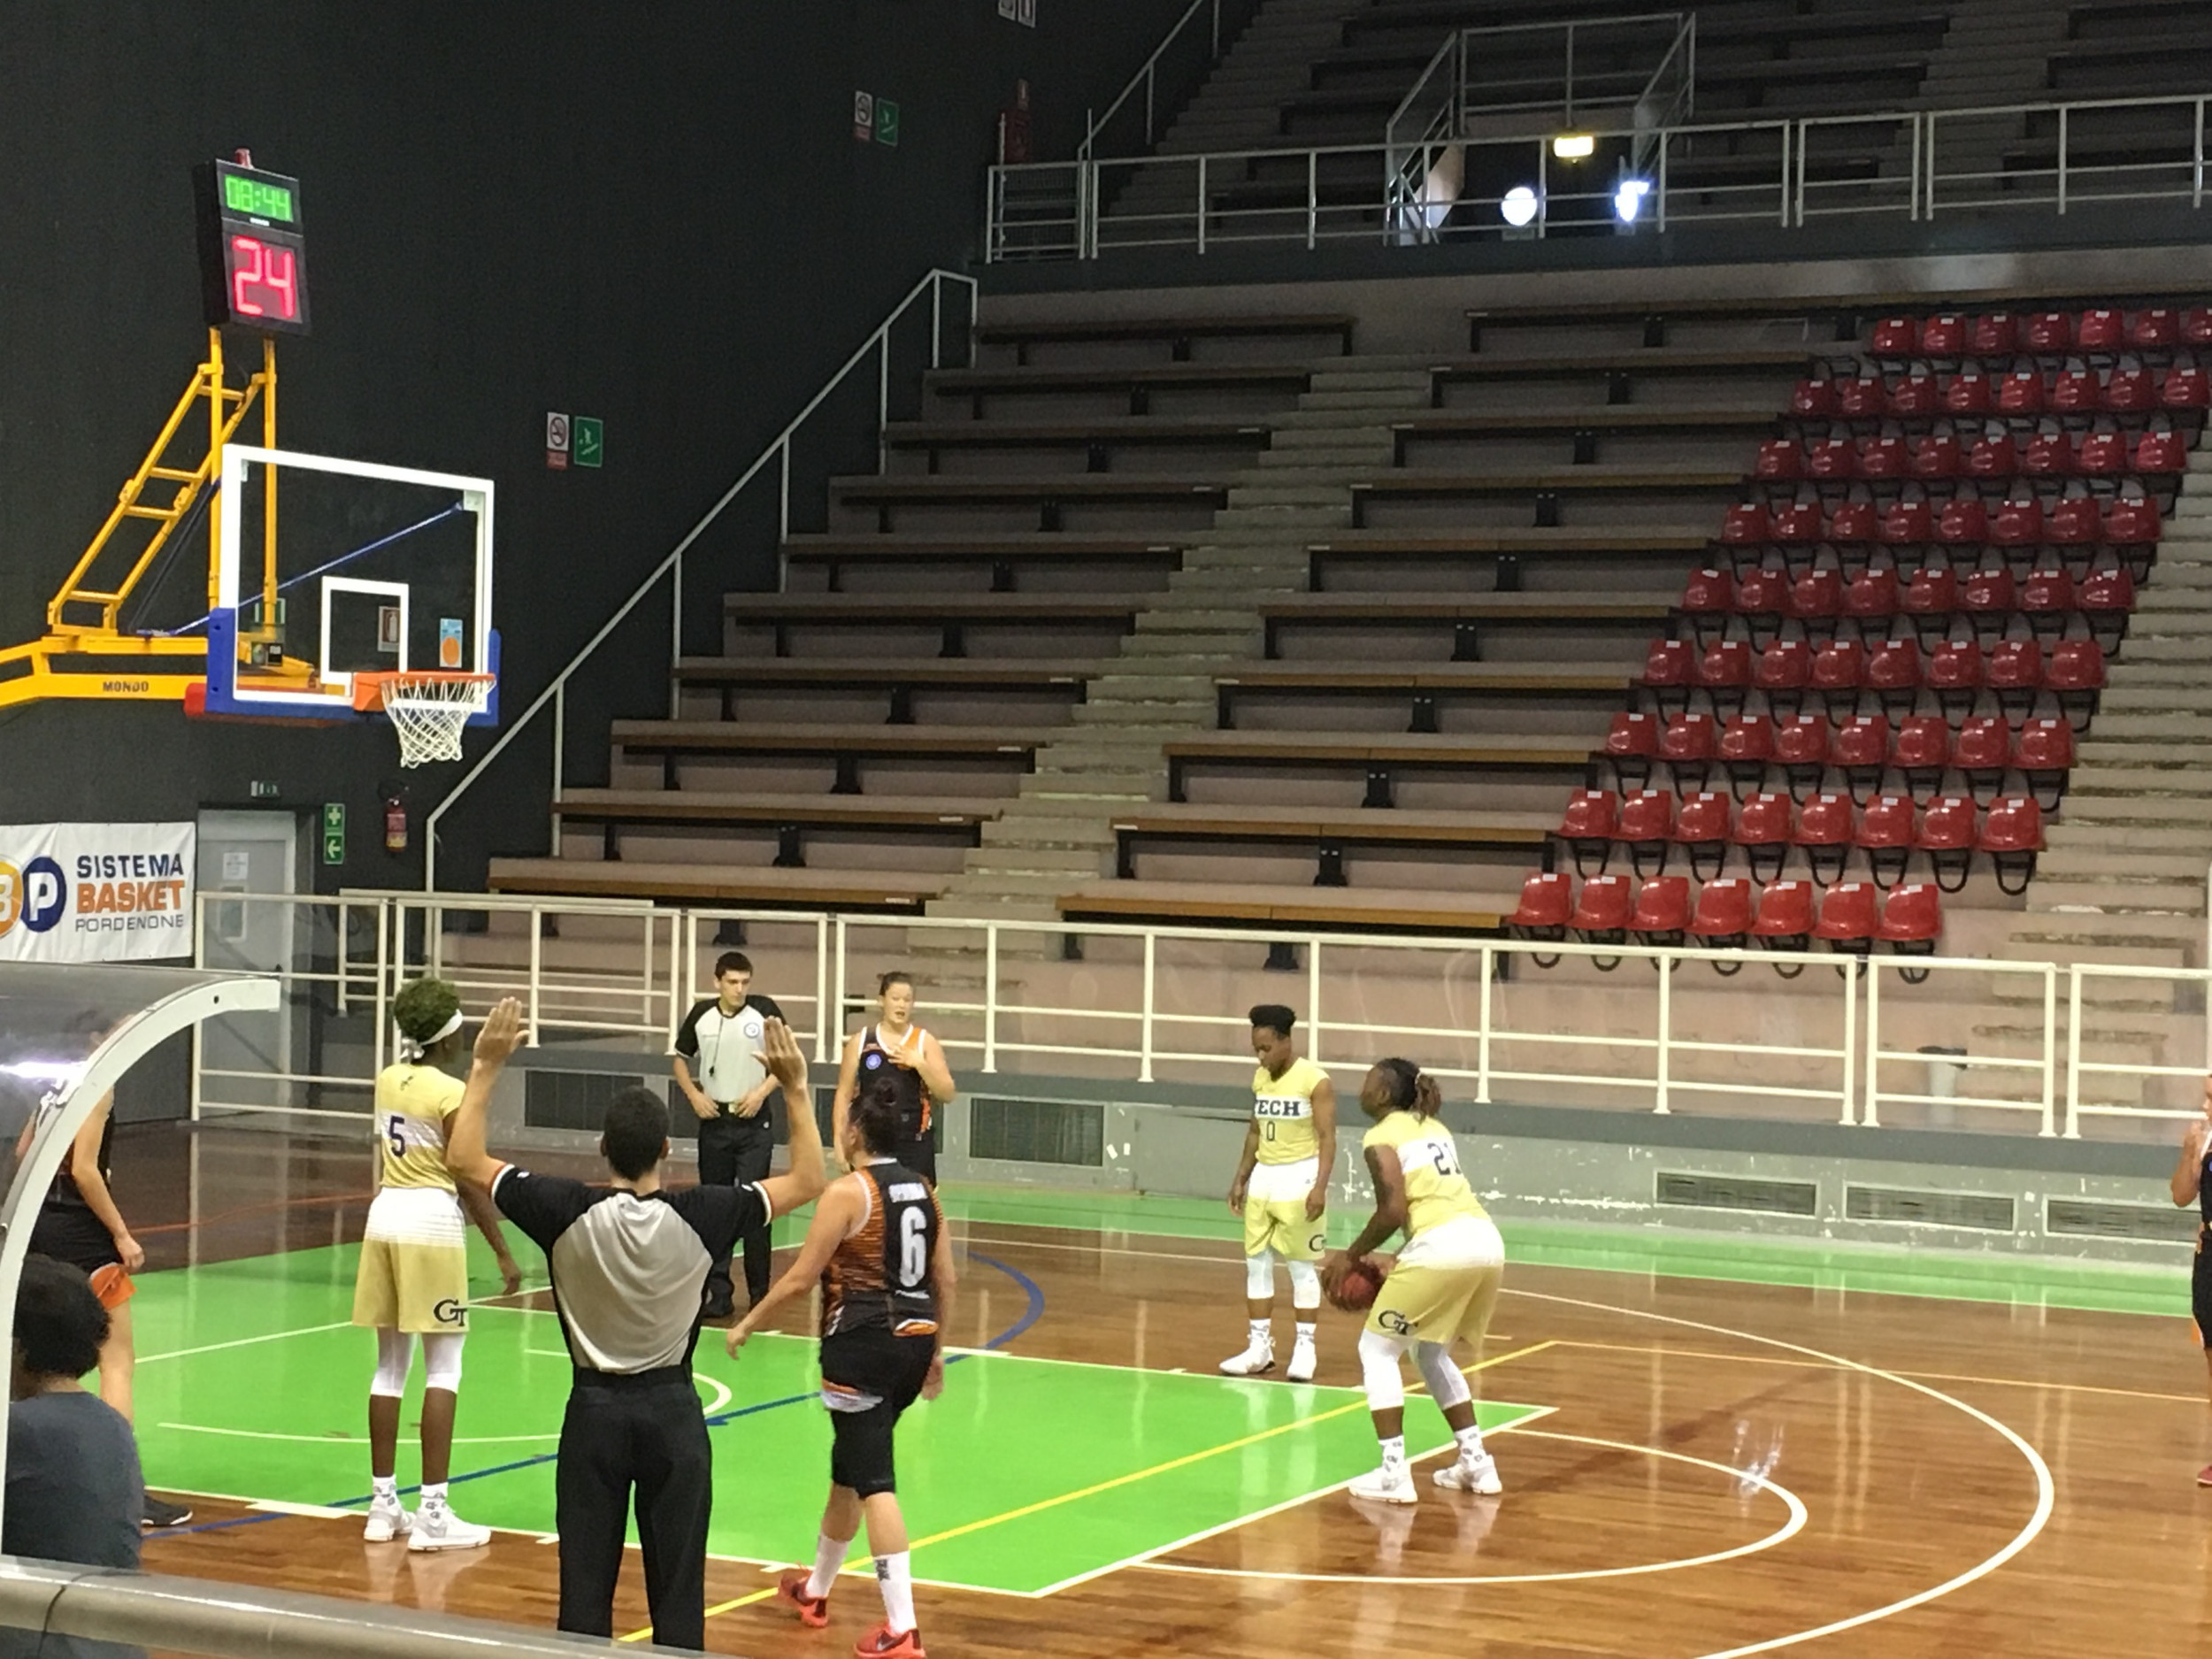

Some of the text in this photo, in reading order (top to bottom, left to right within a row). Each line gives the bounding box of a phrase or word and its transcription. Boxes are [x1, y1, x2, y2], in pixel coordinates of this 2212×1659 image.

[225, 174, 294, 223] 08:44
[232, 236, 296, 318] 24
[103, 680, 150, 693] MONDO
[76, 853, 185, 879] SISTEMA
[76, 879, 185, 914] BASKET
[75, 914, 185, 933] PORDENONE
[1256, 1099, 1301, 1117] ECH
[389, 1115, 406, 1157] 5
[1266, 1120, 1276, 1141] 0
[899, 1206, 927, 1287] 6
[434, 1299, 467, 1327] GT
